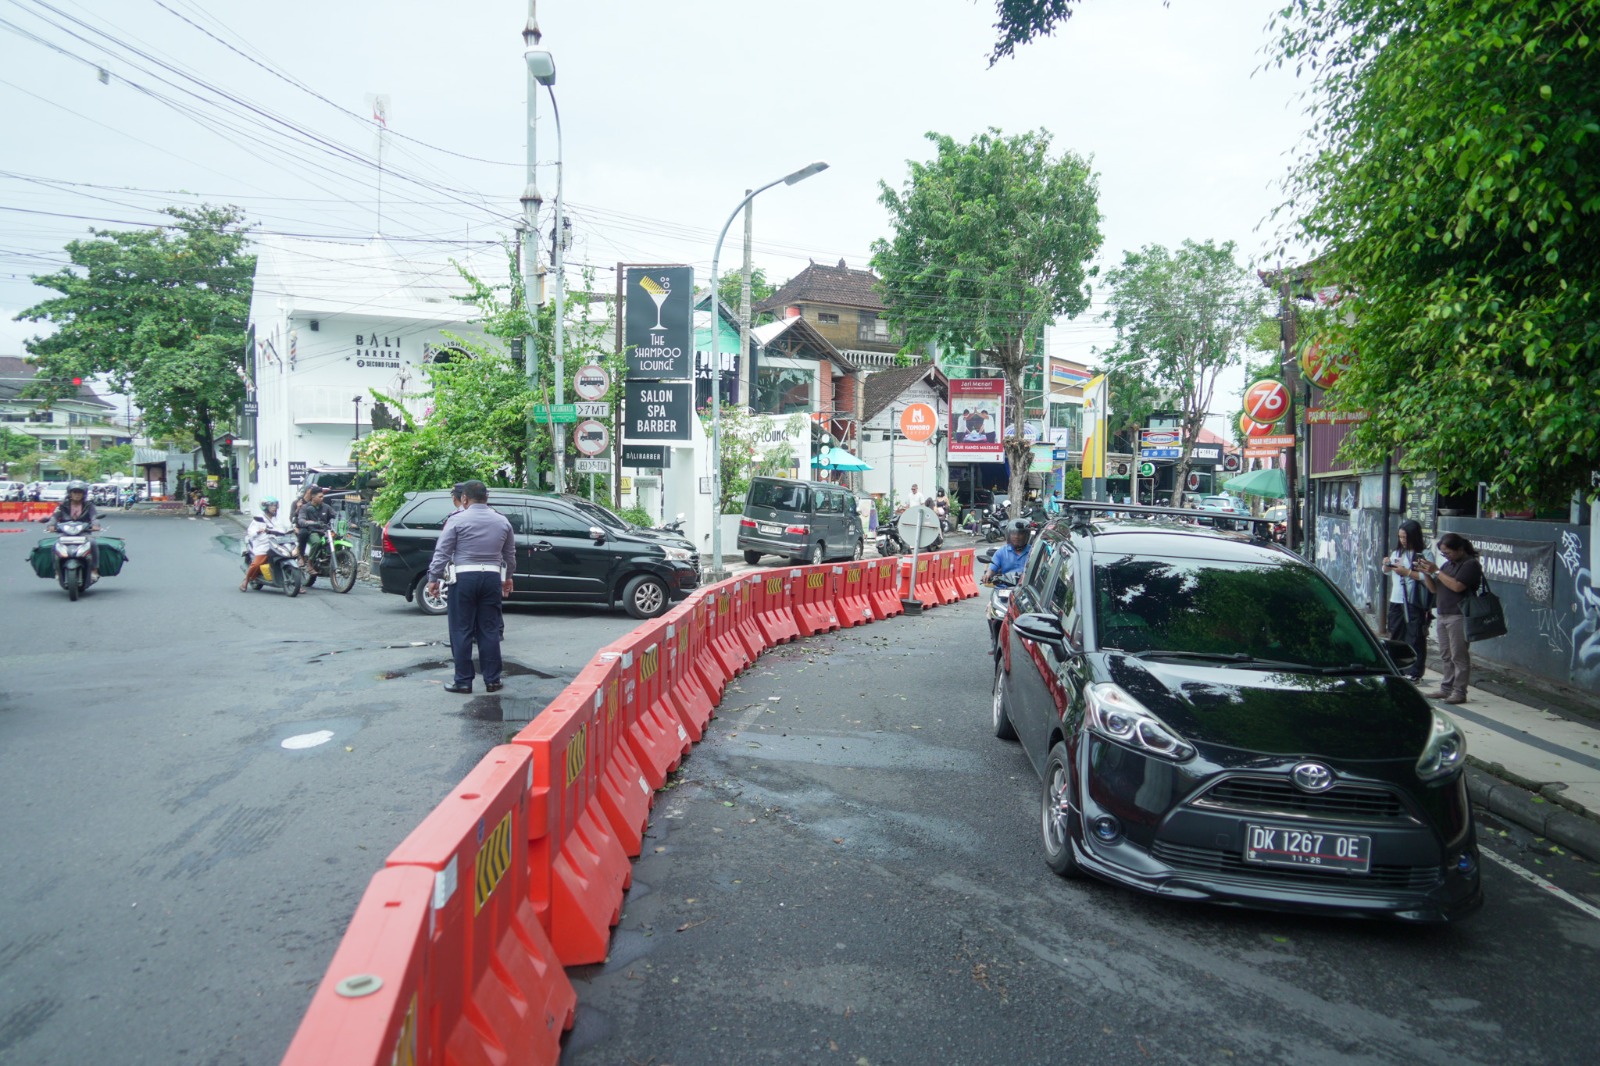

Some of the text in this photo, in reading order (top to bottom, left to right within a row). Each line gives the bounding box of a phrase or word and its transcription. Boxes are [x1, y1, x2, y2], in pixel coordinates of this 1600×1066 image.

[356, 333, 400, 348] BALI
[650, 333, 665, 346] THE
[357, 349, 400, 359] BARBER
[634, 347, 682, 358] SHAMPOO
[640, 358, 675, 371] LOUNGE
[640, 390, 673, 403] SALON
[1250, 383, 1283, 417] 76
[647, 405, 667, 418] SPA
[637, 419, 677, 433] BARBER
[1486, 556, 1528, 580] MANAH
[1253, 828, 1275, 850] DK
[1283, 832, 1324, 855] 1267
